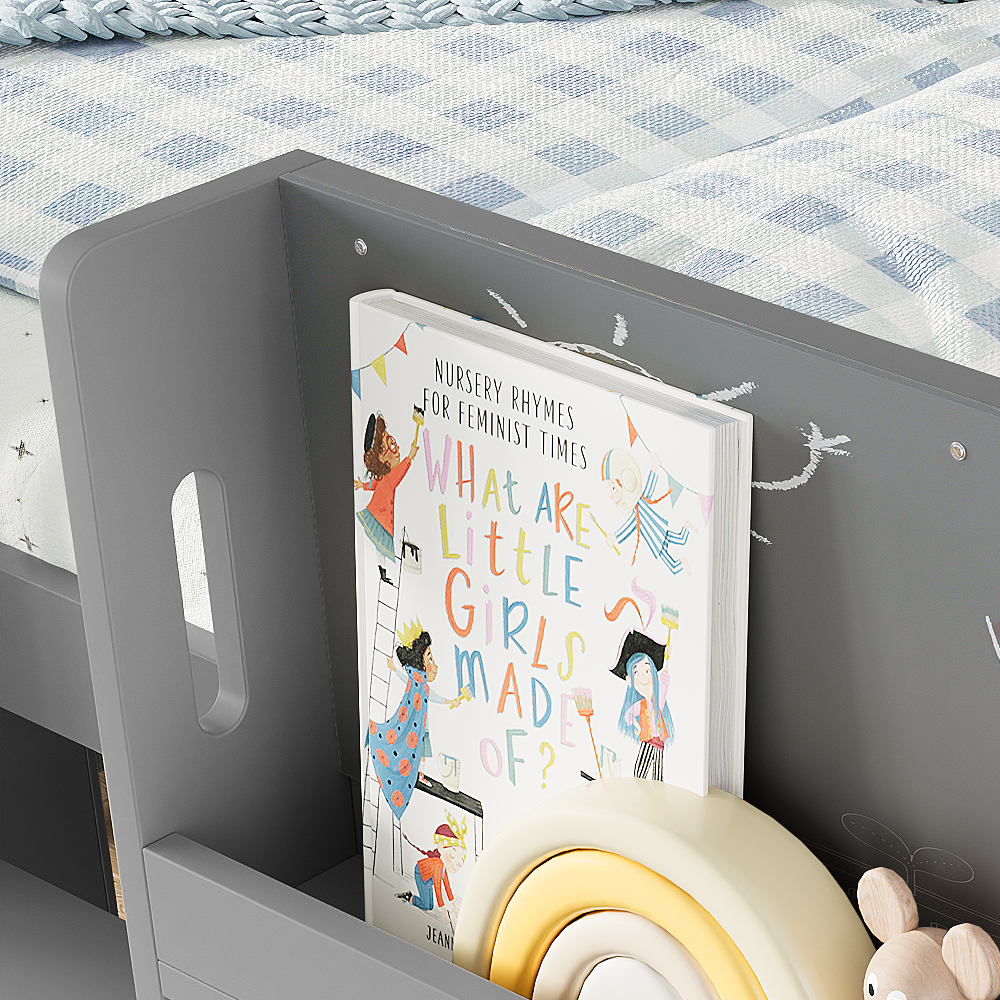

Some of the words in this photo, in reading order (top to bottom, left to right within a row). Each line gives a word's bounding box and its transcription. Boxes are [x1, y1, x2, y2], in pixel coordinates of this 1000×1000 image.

[423, 387, 451, 420] FOR
[458, 400, 531, 449] FEMINIST
[539, 429, 587, 470] TIMES
[435, 357, 503, 404] NURSERY
[511, 385, 574, 431] RHYMES
[535, 482, 591, 550] ARE
[480, 729, 556, 790] OF?
